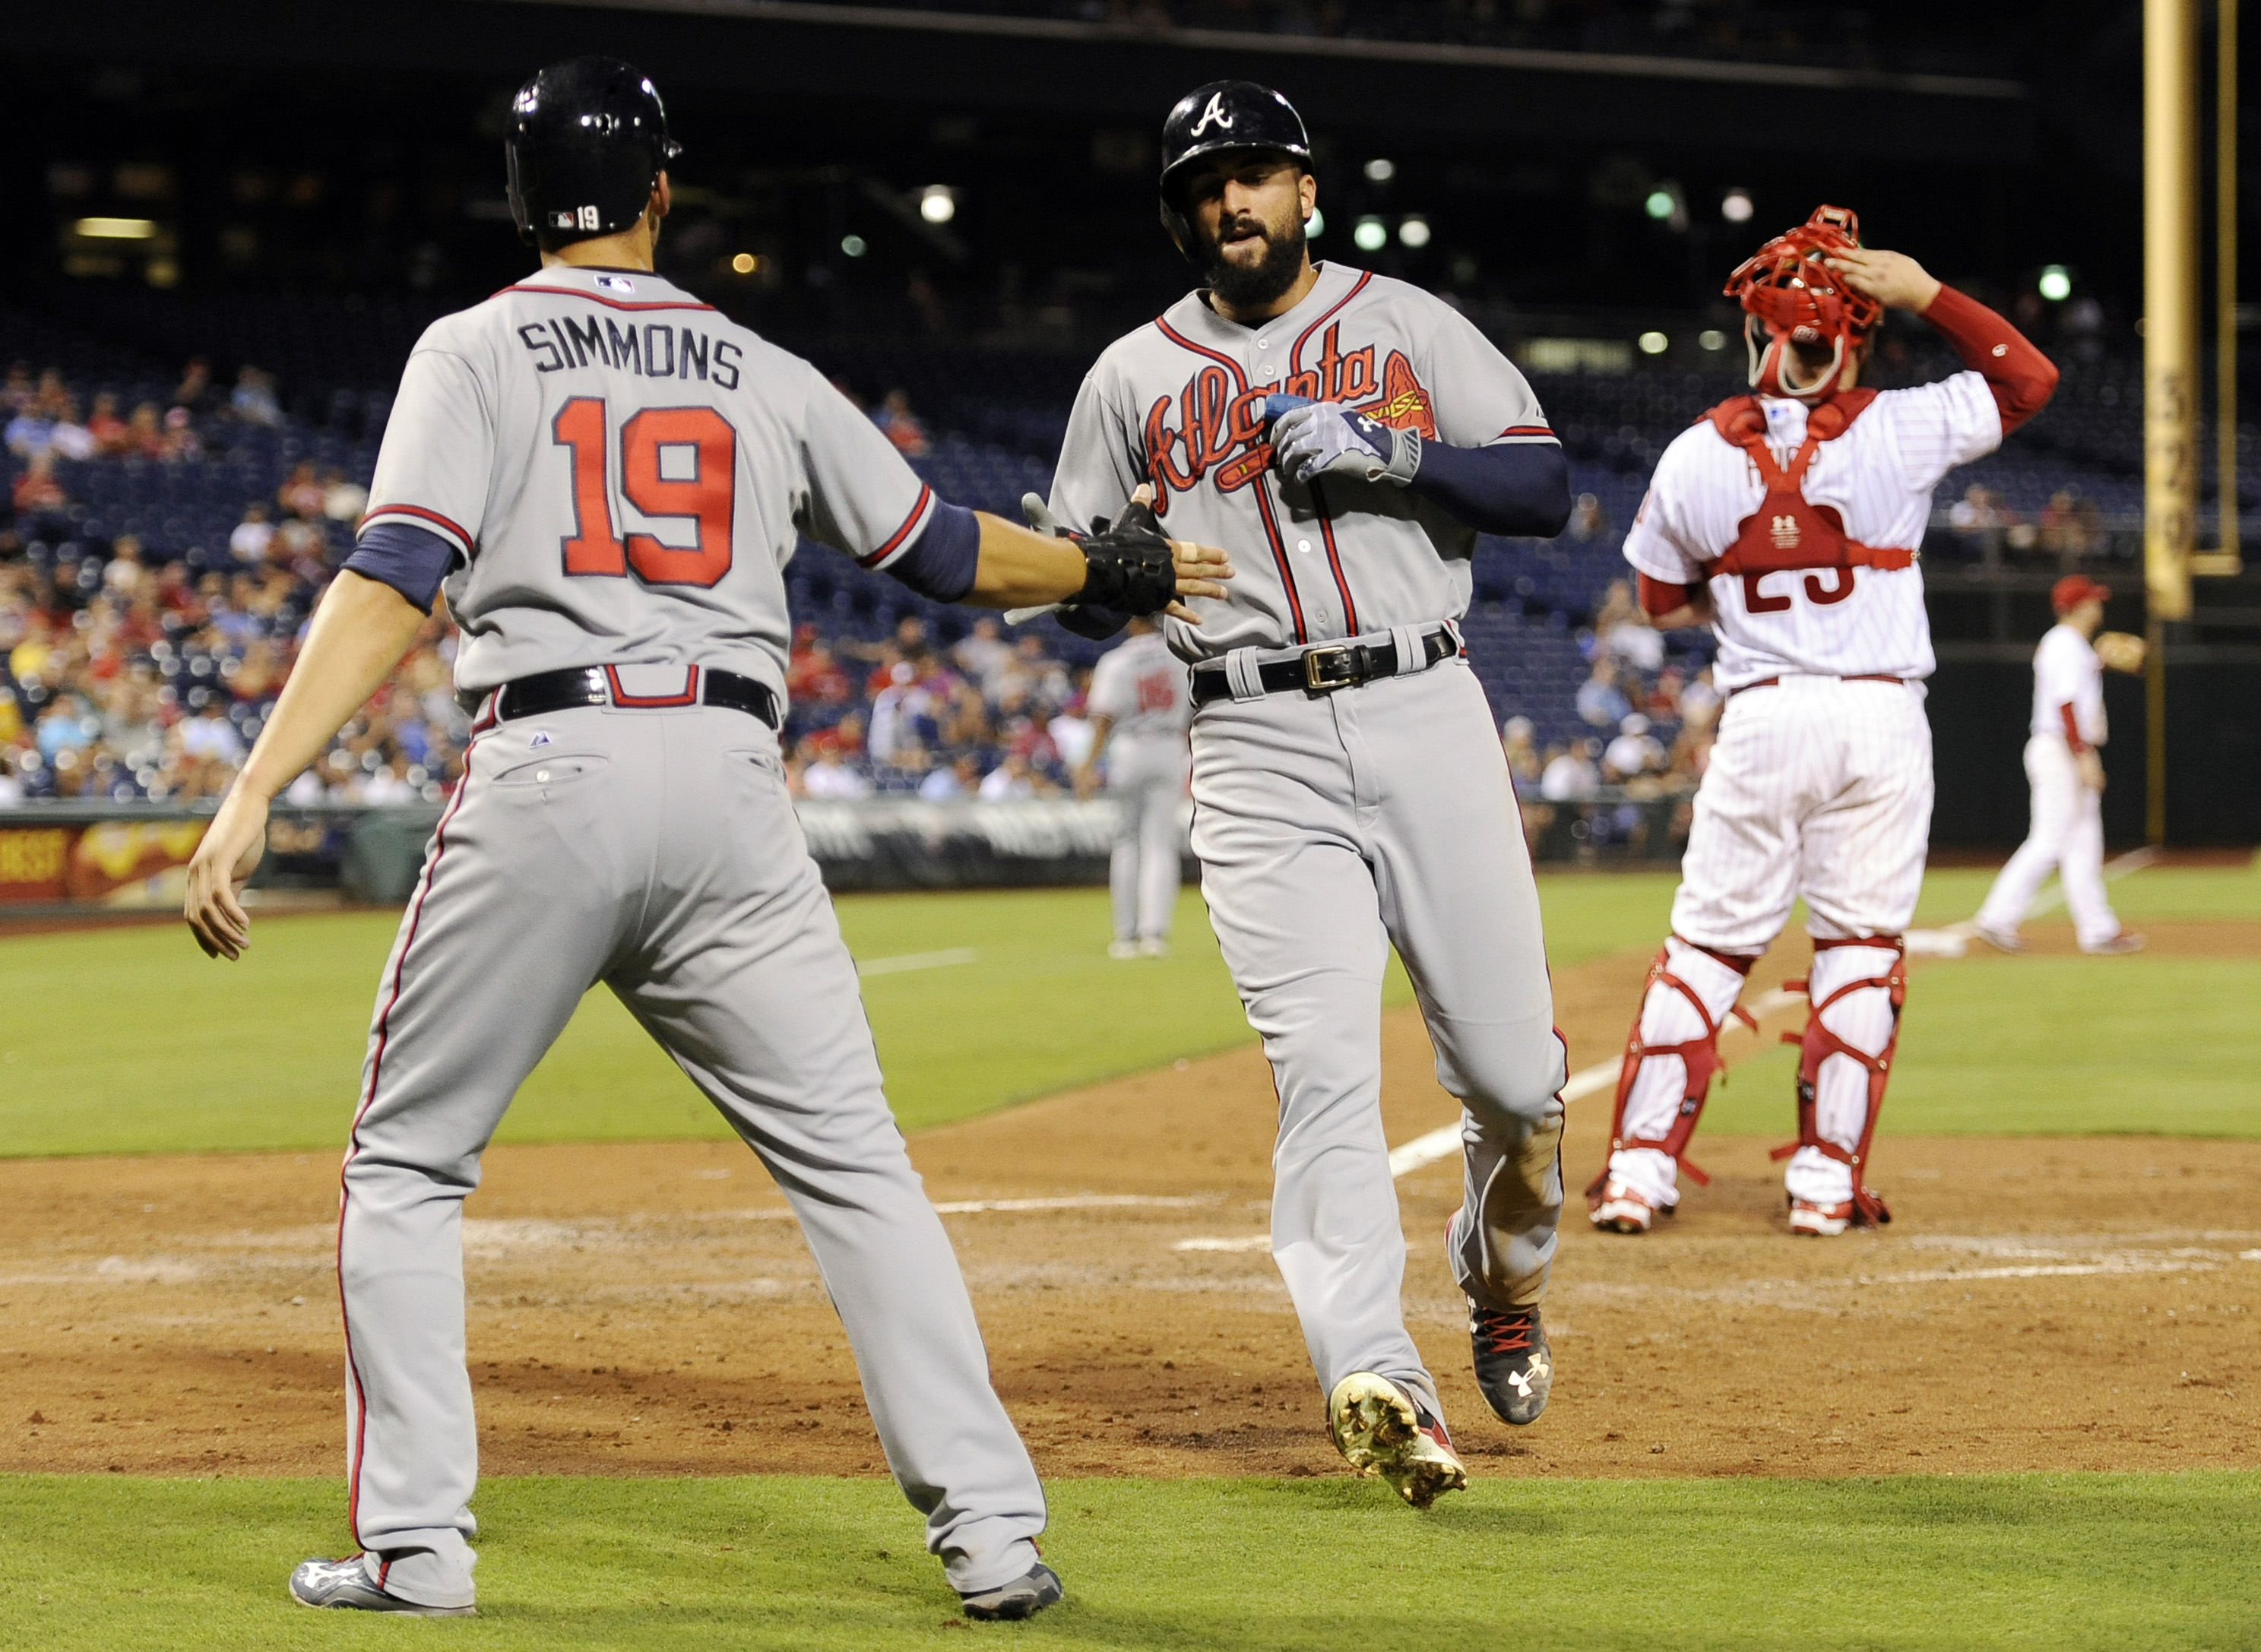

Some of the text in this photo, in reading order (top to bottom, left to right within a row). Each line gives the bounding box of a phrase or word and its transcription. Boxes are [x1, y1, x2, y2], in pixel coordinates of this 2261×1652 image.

[1190, 91, 1233, 138] A
[577, 204, 600, 231] 19
[517, 314, 743, 391] SIMMONS
[1144, 318, 1379, 518] Atlanta
[550, 394, 736, 589] 19
